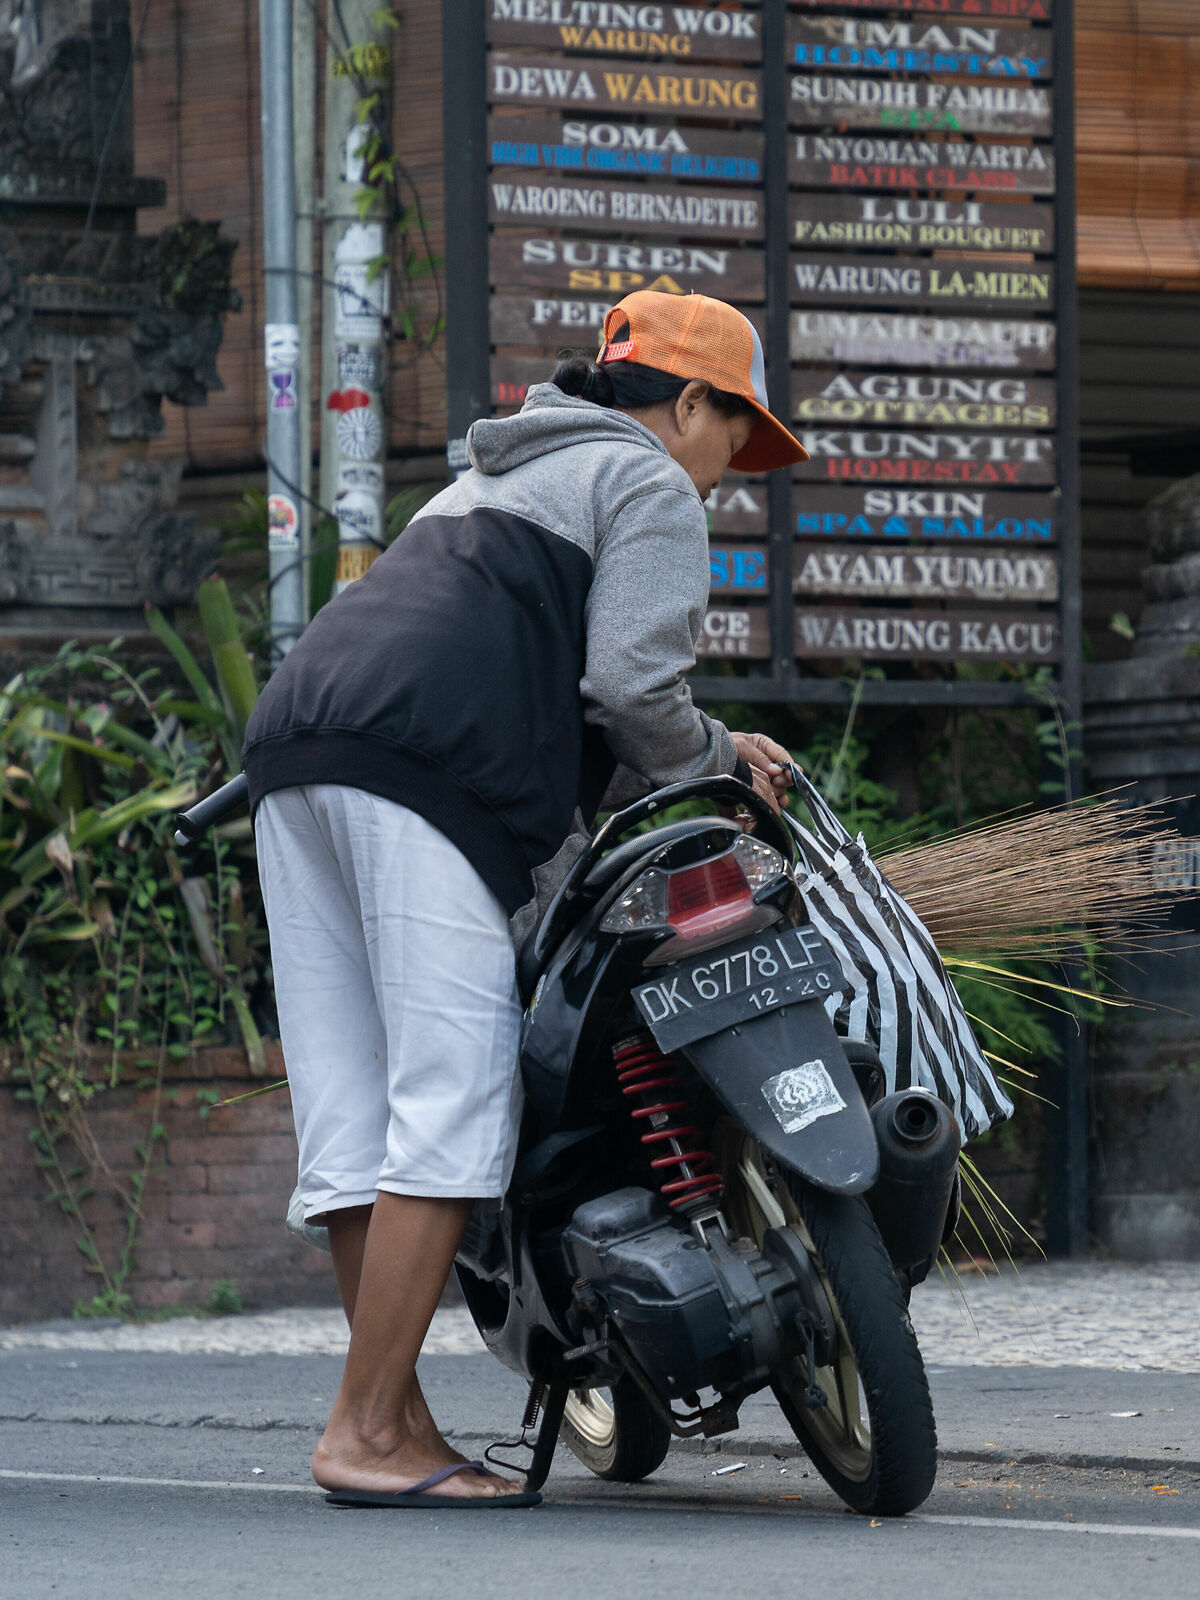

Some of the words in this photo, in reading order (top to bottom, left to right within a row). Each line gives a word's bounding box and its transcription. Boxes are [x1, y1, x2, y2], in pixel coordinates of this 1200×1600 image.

[492, 0, 664, 31] MELTING
[673, 8, 757, 38] WOK
[560, 26, 692, 55] WARUNG
[843, 20, 998, 52] IMAN
[794, 44, 1047, 76] HOMESTAY
[493, 66, 597, 99] DEWA
[603, 72, 758, 108] WARUNG
[790, 75, 918, 106] SUNDIH
[926, 83, 1048, 116] FAMILY
[879, 109, 963, 131] SPA
[562, 122, 690, 152] SOMA
[491, 141, 539, 166] HIGH
[587, 147, 669, 175] ORGANIC
[671, 154, 760, 181] DELIGHTS
[815, 137, 938, 165] NYOMAN
[946, 144, 1048, 170] WARTA
[829, 164, 919, 187] BATIK
[926, 168, 1017, 188] CLASS
[491, 183, 605, 217] WAROENG
[610, 191, 759, 227] BERNADETTE
[861, 198, 984, 225] LULI
[795, 220, 912, 242] FASHION
[919, 225, 1045, 248] BOUQUET
[522, 239, 731, 275] SUREN
[568, 268, 686, 294] SPA
[795, 264, 921, 294] WARUNG
[821, 374, 1027, 403] AGUNG
[798, 397, 1049, 425] COTTAGES
[799, 431, 1053, 463] KUNYIT
[826, 457, 1024, 482] HOMESTAY
[863, 490, 987, 517] SKIN
[797, 512, 874, 535] SPA
[882, 516, 911, 536] &
[922, 516, 1053, 539] SALON
[798, 552, 905, 586] AYAM
[914, 555, 1051, 590] YUMMY
[799, 614, 951, 650] WARUNG
[959, 621, 1055, 654] KACU
[639, 977, 694, 1022] DK
[691, 945, 779, 999] 6778
[776, 929, 822, 970] LF
